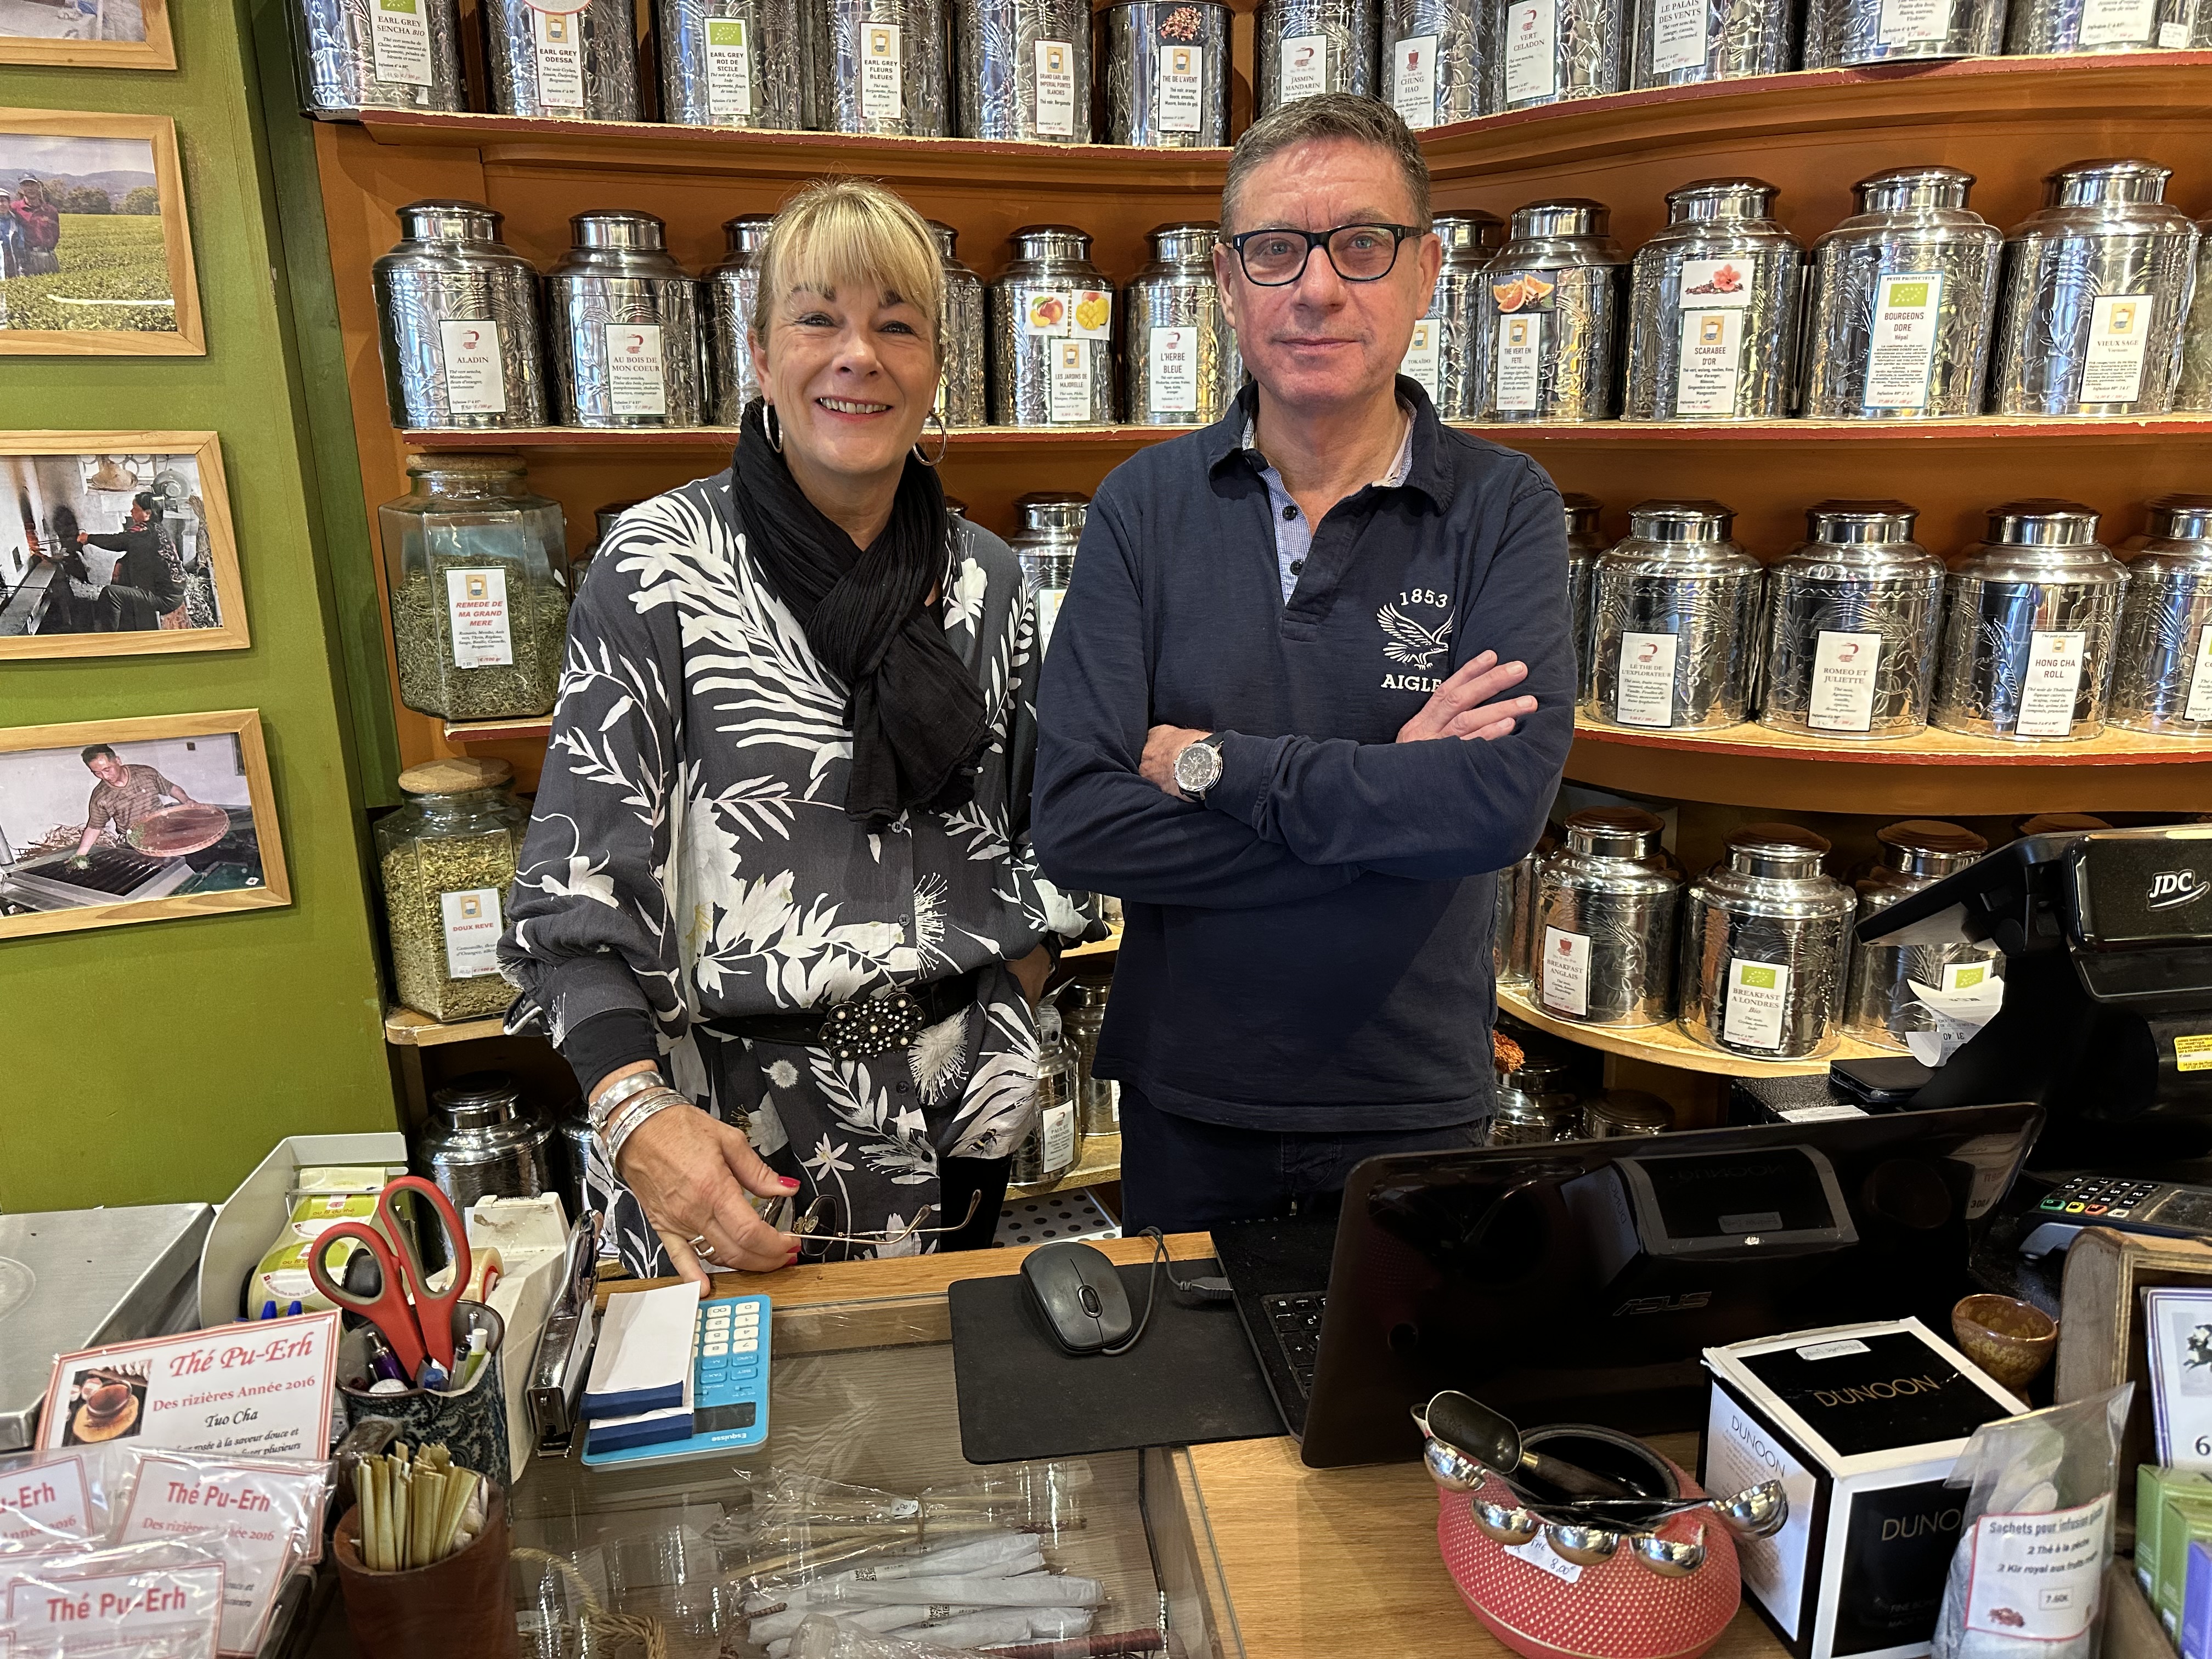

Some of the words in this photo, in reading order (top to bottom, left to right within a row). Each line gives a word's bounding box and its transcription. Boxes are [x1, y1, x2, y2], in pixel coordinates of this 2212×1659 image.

[1661, 4, 1670, 13] LE
[1672, 0, 1699, 10] PALAIS
[378, 16, 399, 24] EARL
[402, 19, 421, 27] GREY
[1659, 14, 1672, 24] DES
[1674, 8, 1701, 19] VENTS
[377, 25, 410, 34] SENCHA
[1520, 32, 1537, 41] VERT
[1514, 39, 1544, 51] CELADON
[1291, 75, 1313, 84] JASMIN
[1401, 76, 1424, 86] CHUNG
[1285, 83, 1320, 91] MANDARIN
[1161, 353, 1185, 361] L'HERBE
[1163, 365, 1182, 374] BLEUE
[1400, 588, 1448, 608] 1853
[1622, 669, 1671, 678] L'EXPLORATEUR
[1824, 676, 1865, 684] JULIETTE
[2149, 872, 2192, 898] JDC
[1547, 959, 1584, 974] BREAKFAST
[1550, 968, 1578, 980] ANGLAIS
[1733, 988, 1780, 1001] BREAKFAST
[1738, 997, 1779, 1008] LONDRES
[170, 1350, 218, 1378] Thé
[221, 1331, 315, 1368] Pu-Erh
[153, 1399, 179, 1412] Des
[182, 1390, 234, 1408] rizières
[238, 1382, 283, 1397] Année
[285, 1376, 315, 1391] 2016
[1813, 1375, 1942, 1407] DUNOON
[205, 1414, 229, 1428] Tuo
[233, 1408, 258, 1424] Cha
[216, 1439, 222, 1448] à
[224, 1437, 232, 1447] la
[234, 1434, 264, 1446] saveur
[264, 1430, 289, 1441] douce
[290, 1428, 299, 1436] et
[712, 1433, 747, 1442] Esquisse
[264, 1442, 301, 1455] plusieurs
[1731, 1414, 1786, 1479] DUNOON
[0, 1482, 56, 1514] -Erh
[167, 1481, 200, 1505] Thé
[204, 1485, 271, 1513] Pu-Erh
[142, 1517, 164, 1530] Des
[1881, 1509, 1962, 1542] DUNO
[1989, 1521, 2033, 1535] Sachets
[2035, 1522, 2057, 1536] pour
[250, 1530, 274, 1541] 2016
[2027, 1546, 2034, 1555] 2
[2037, 1544, 2052, 1554] Thé
[2007, 1563, 2022, 1572] Kir
[2024, 1562, 2048, 1575] royal
[47, 1592, 90, 1623] Thé
[99, 1585, 187, 1618] Pu-Erh
